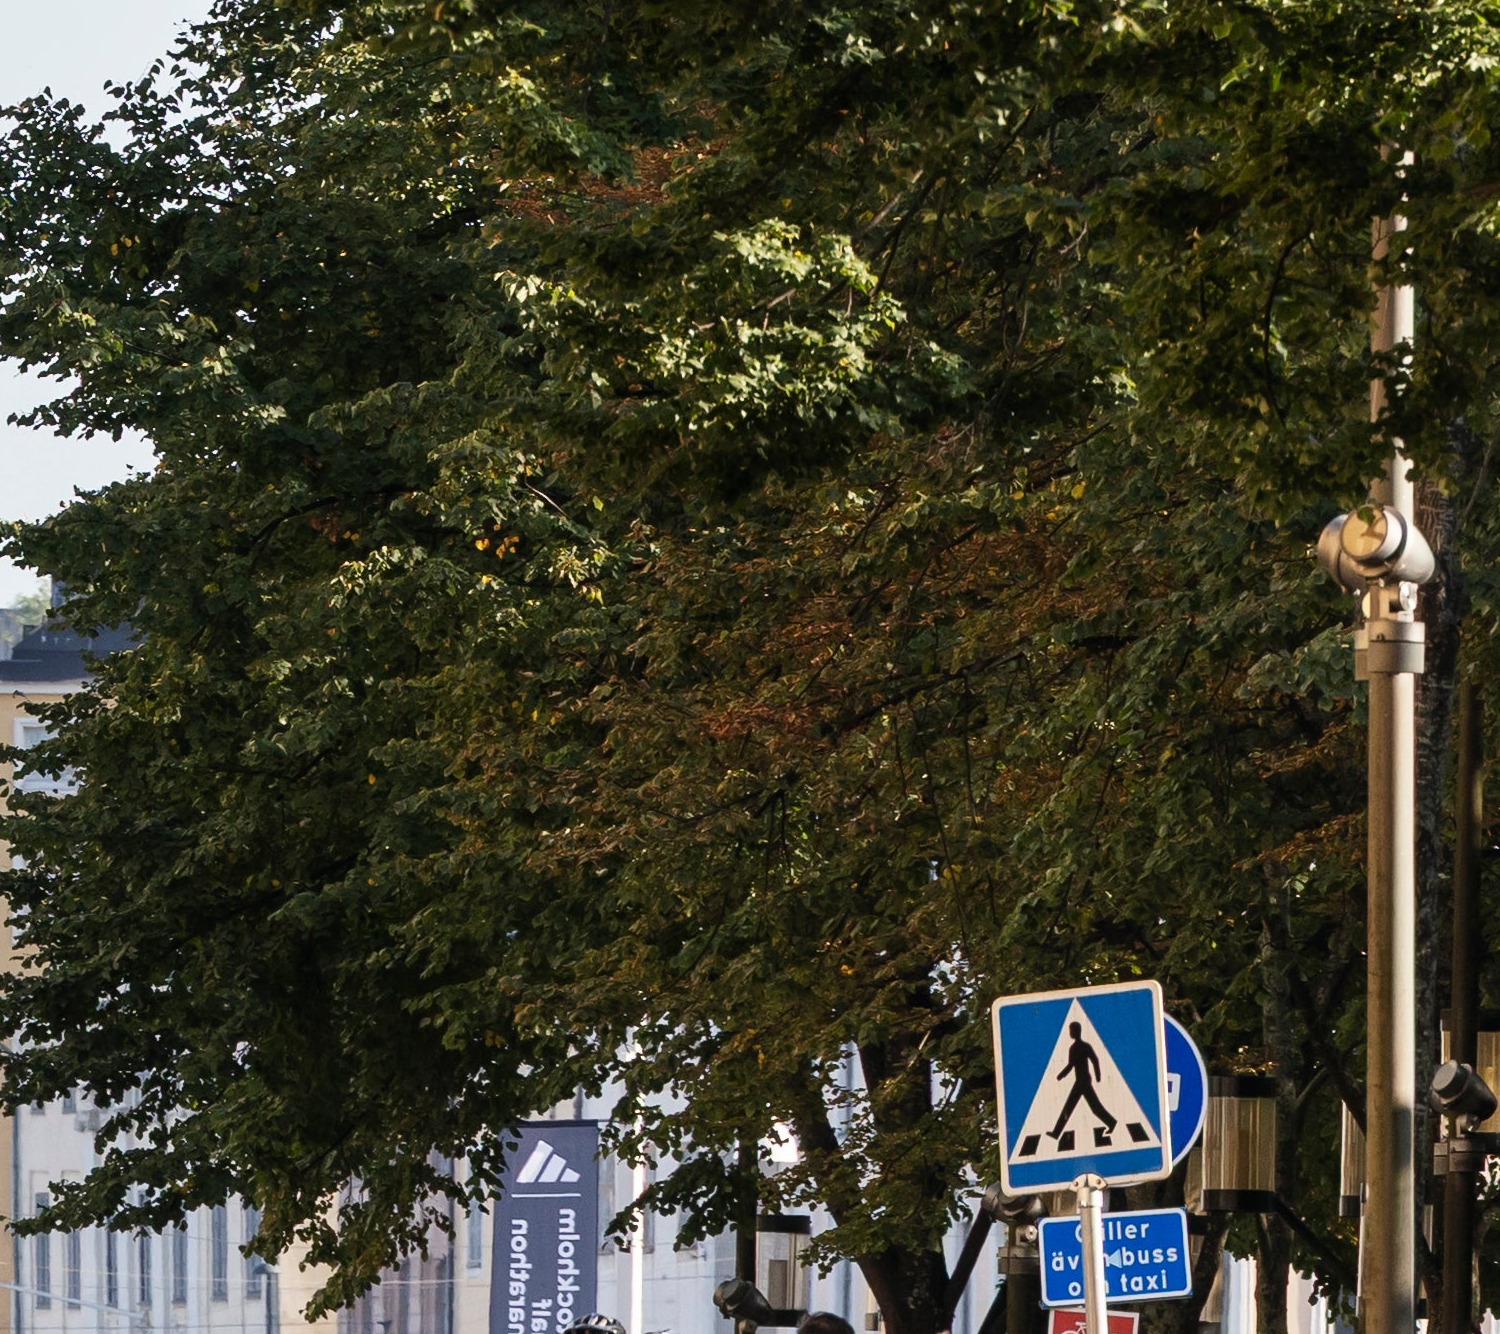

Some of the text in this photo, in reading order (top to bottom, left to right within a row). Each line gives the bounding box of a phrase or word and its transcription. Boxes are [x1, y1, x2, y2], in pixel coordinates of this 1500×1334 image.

[1075, 1221, 1149, 1243] ller
[1052, 1247, 1178, 1272] ävn buss
[1120, 1270, 1167, 1293] taxi
